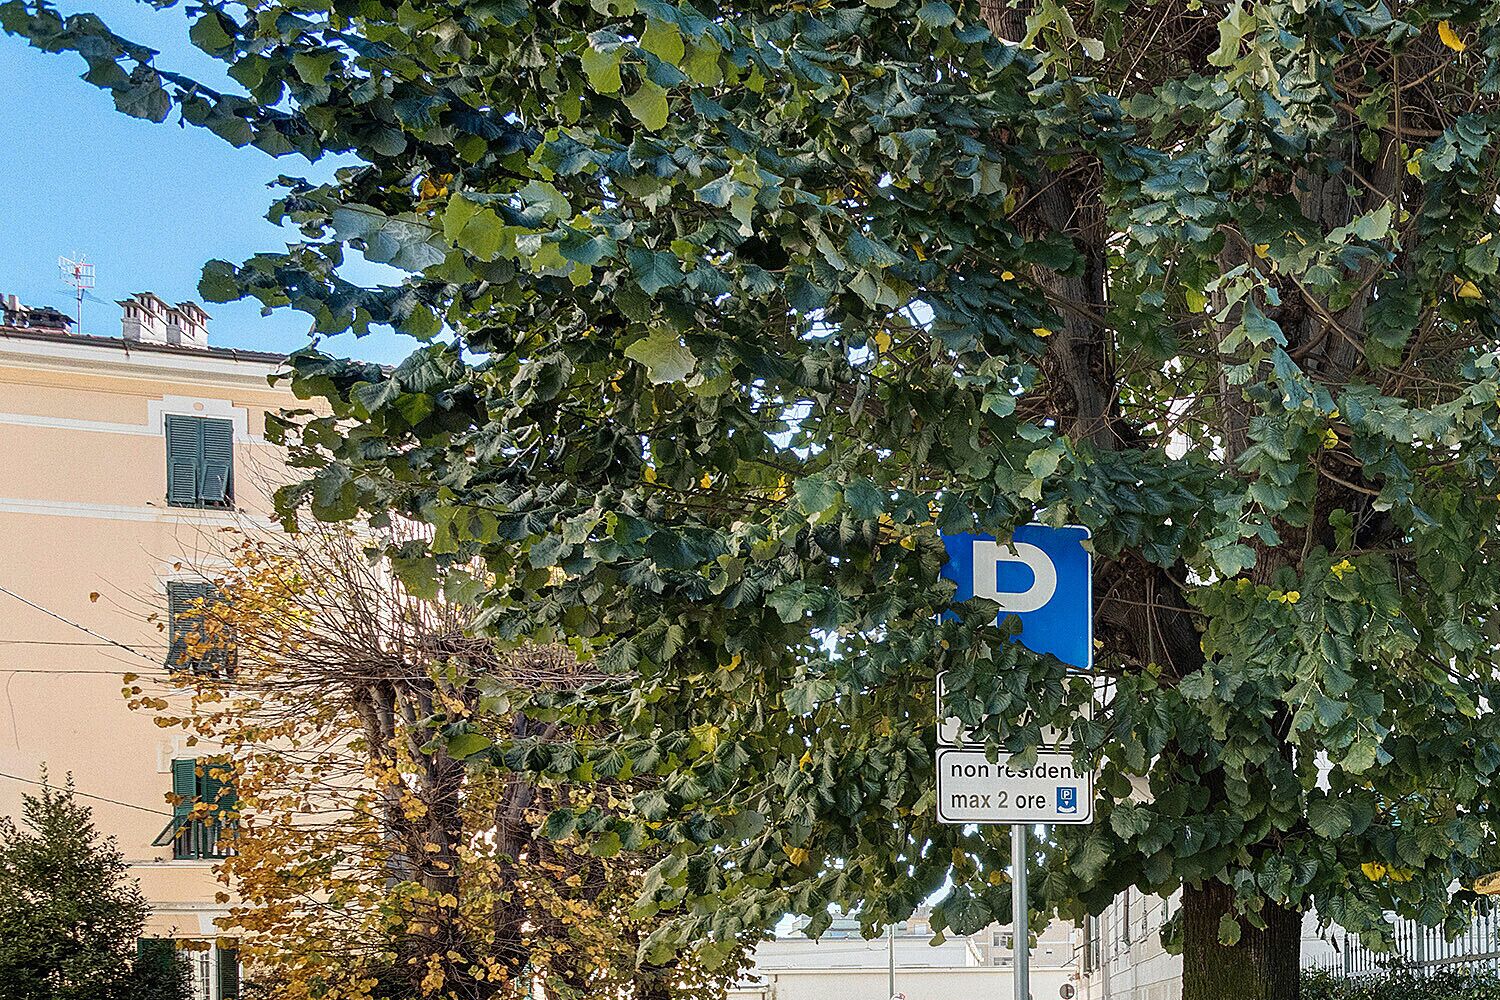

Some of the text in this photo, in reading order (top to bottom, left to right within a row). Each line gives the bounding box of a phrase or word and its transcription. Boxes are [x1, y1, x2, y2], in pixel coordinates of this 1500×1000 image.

[973, 540, 1058, 628] P
[951, 764, 989, 778] non
[951, 791, 1046, 809] max 2 ore
